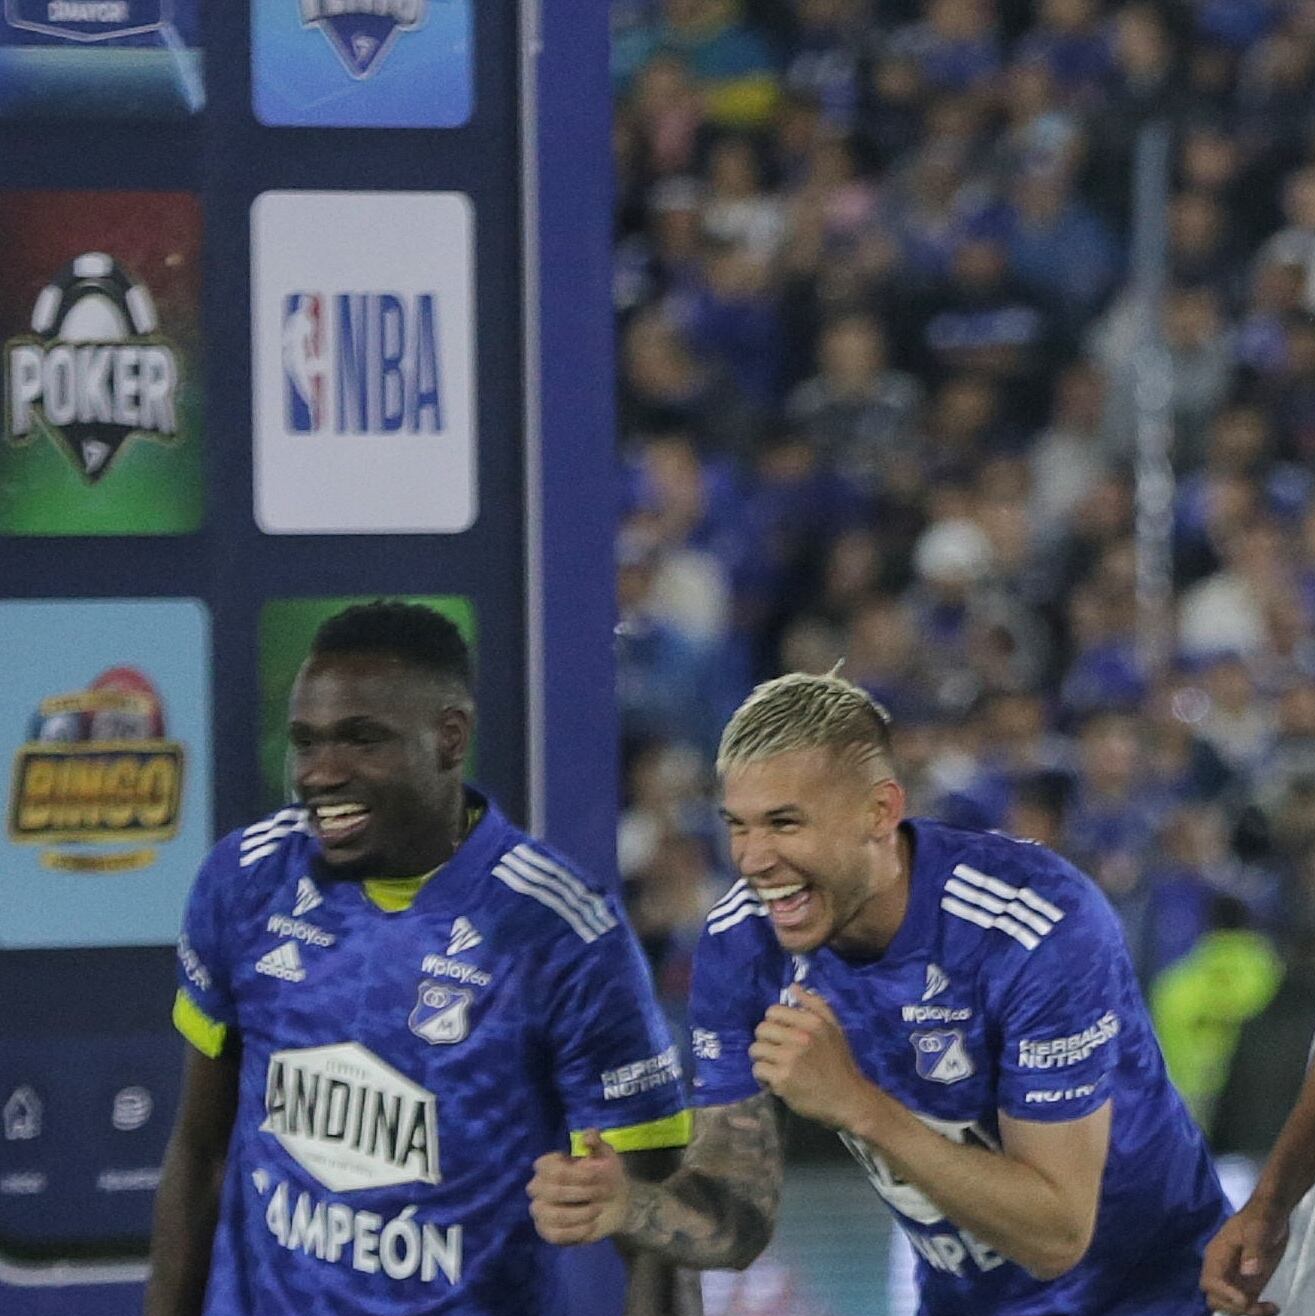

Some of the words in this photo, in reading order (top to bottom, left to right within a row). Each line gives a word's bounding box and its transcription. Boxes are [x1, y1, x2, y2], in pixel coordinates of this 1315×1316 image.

[10, 346, 178, 437] POKER
[333, 294, 443, 434] NBA
[268, 1061, 430, 1178] ANDINA
